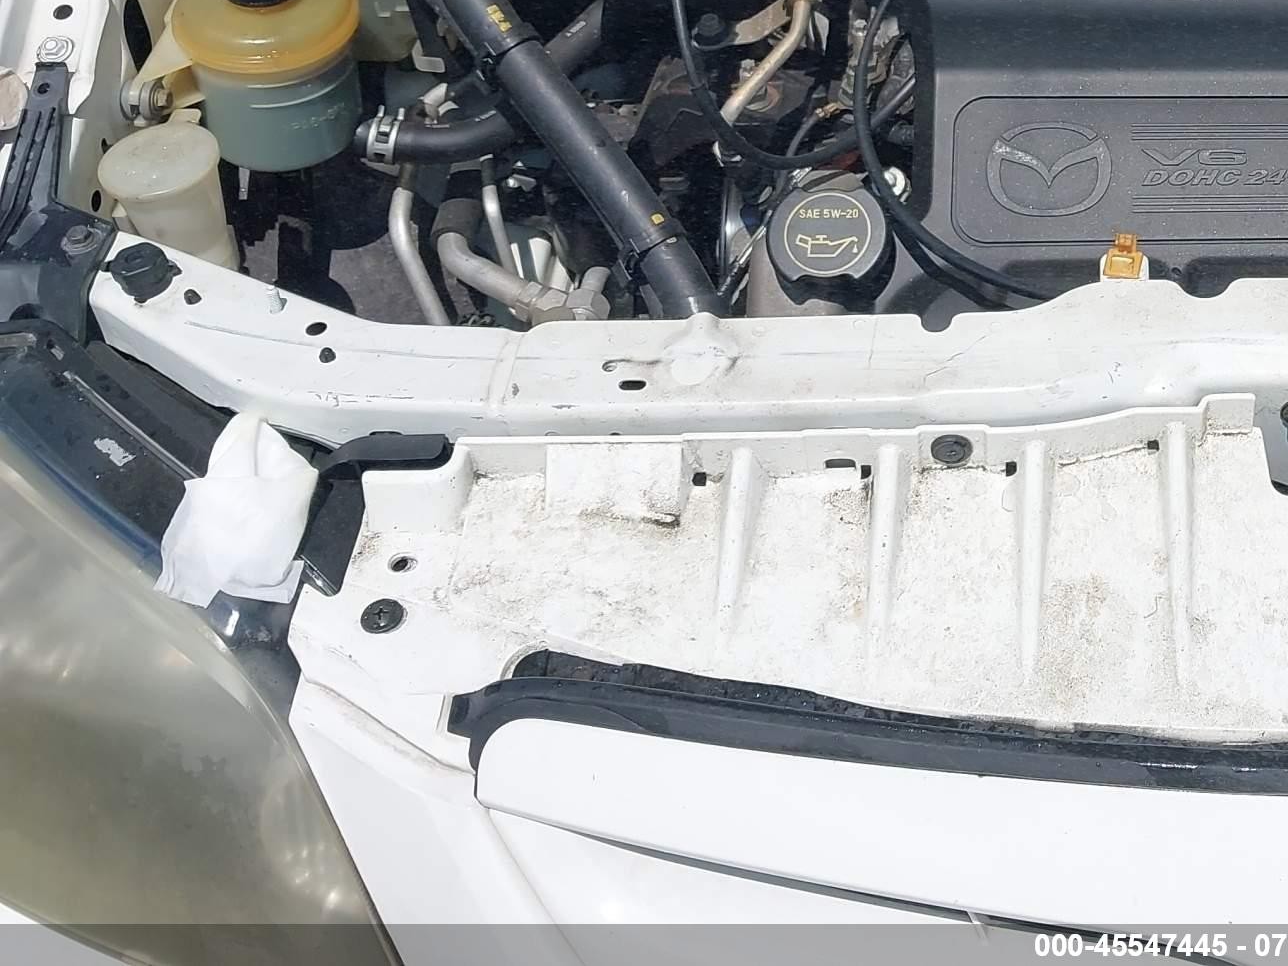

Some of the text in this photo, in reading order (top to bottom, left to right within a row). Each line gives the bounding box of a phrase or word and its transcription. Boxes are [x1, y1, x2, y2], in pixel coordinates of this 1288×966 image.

[1141, 148, 1247, 166] V6
[1141, 169, 1241, 186] DOHC
[799, 209, 859, 218] SAE 5W-20
